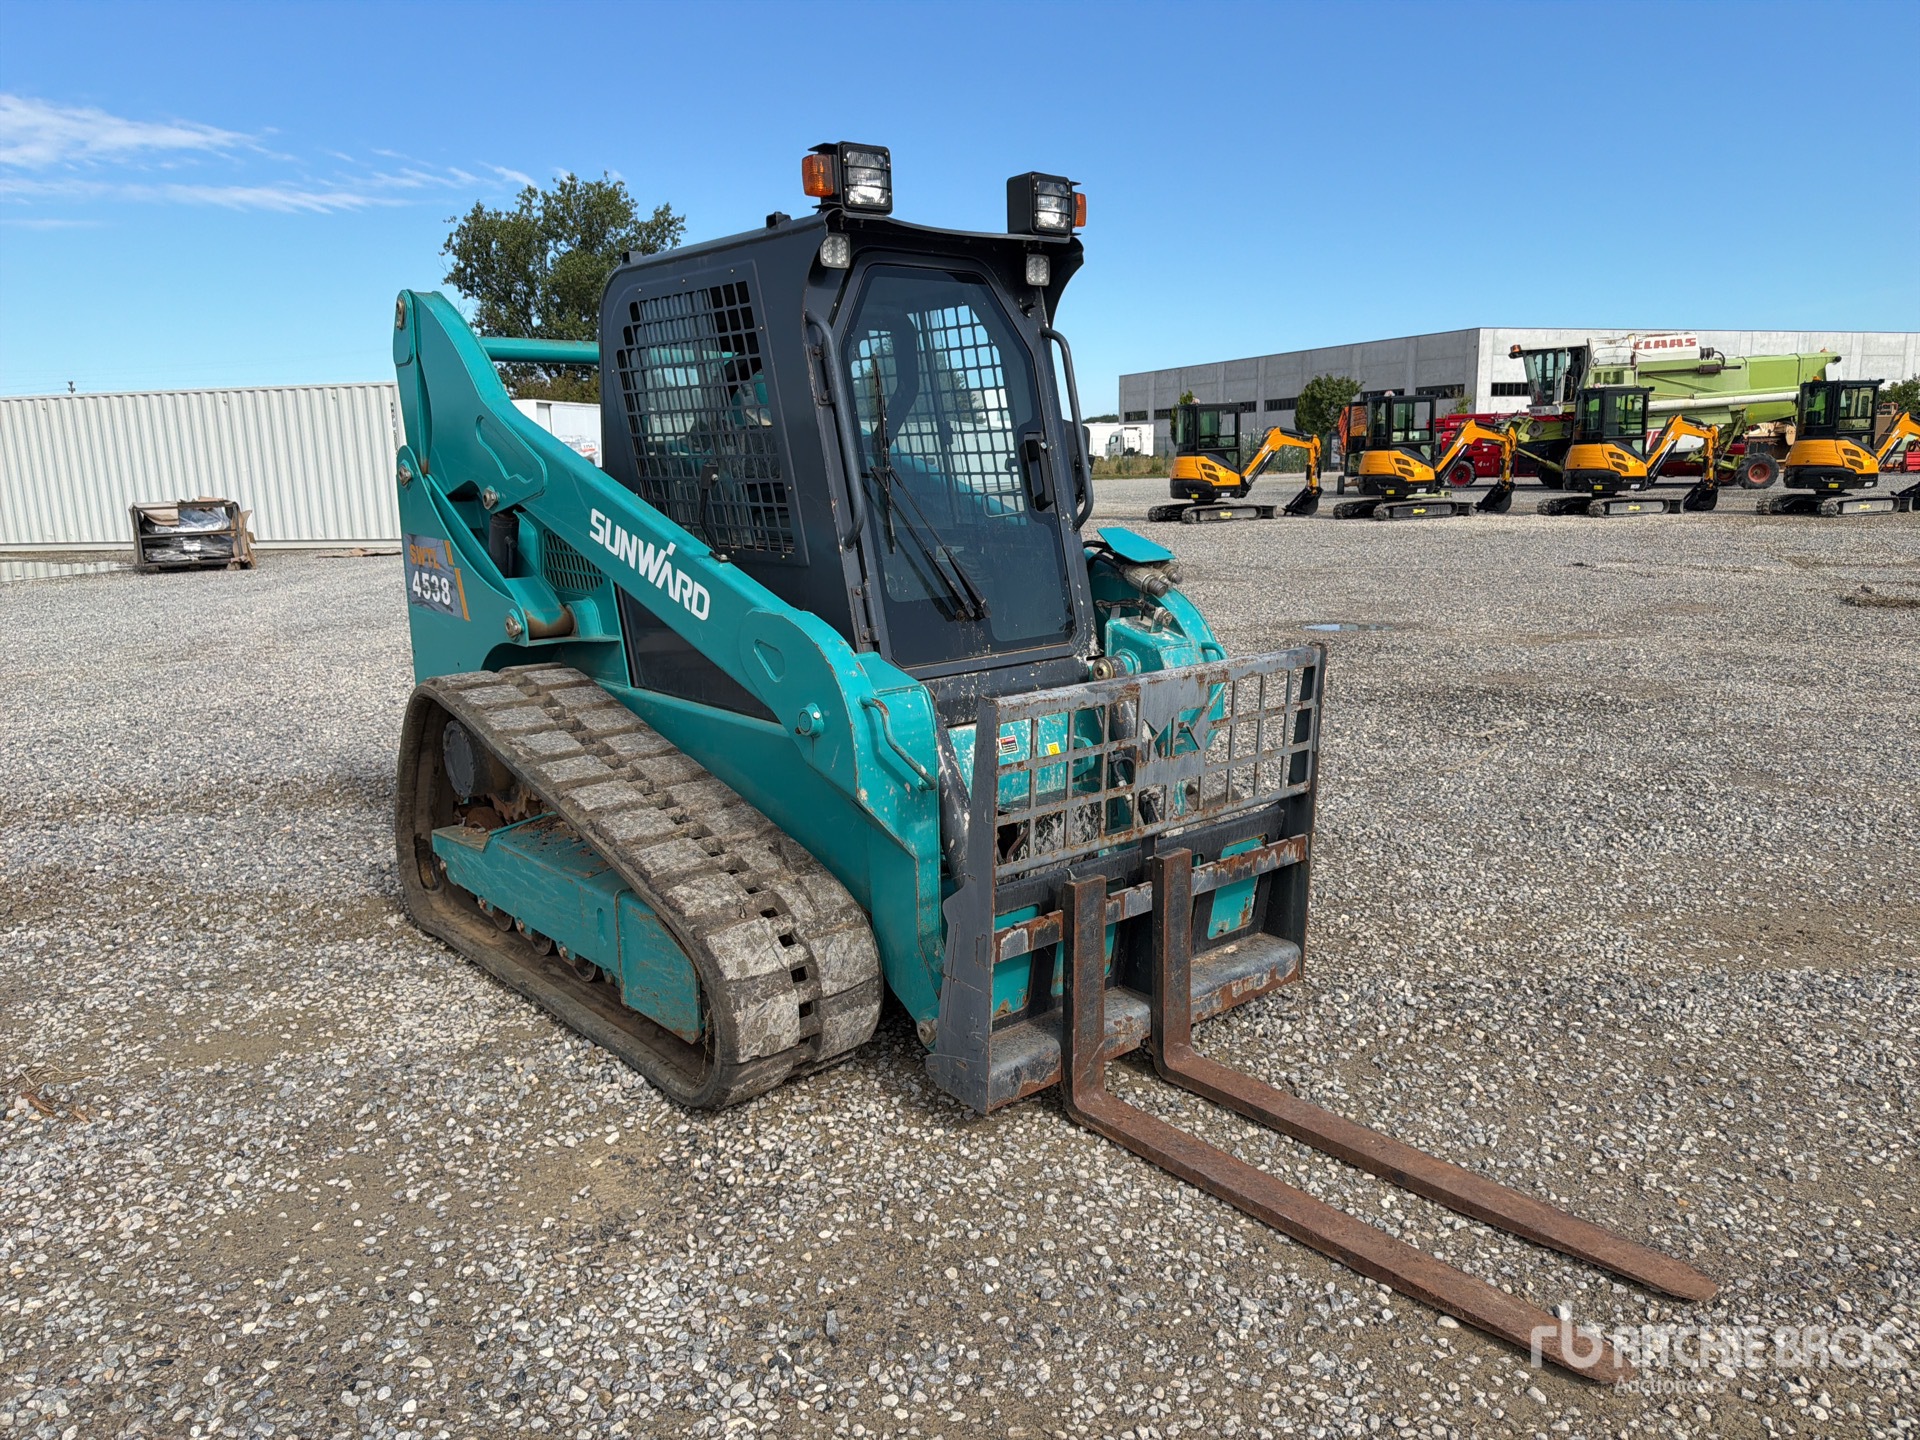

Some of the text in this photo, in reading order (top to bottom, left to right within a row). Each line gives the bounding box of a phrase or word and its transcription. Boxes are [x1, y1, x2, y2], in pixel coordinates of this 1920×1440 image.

[1634, 338, 1697, 350] CLAAS
[589, 508, 710, 621] SUNWARD
[413, 571, 451, 606] 4538
